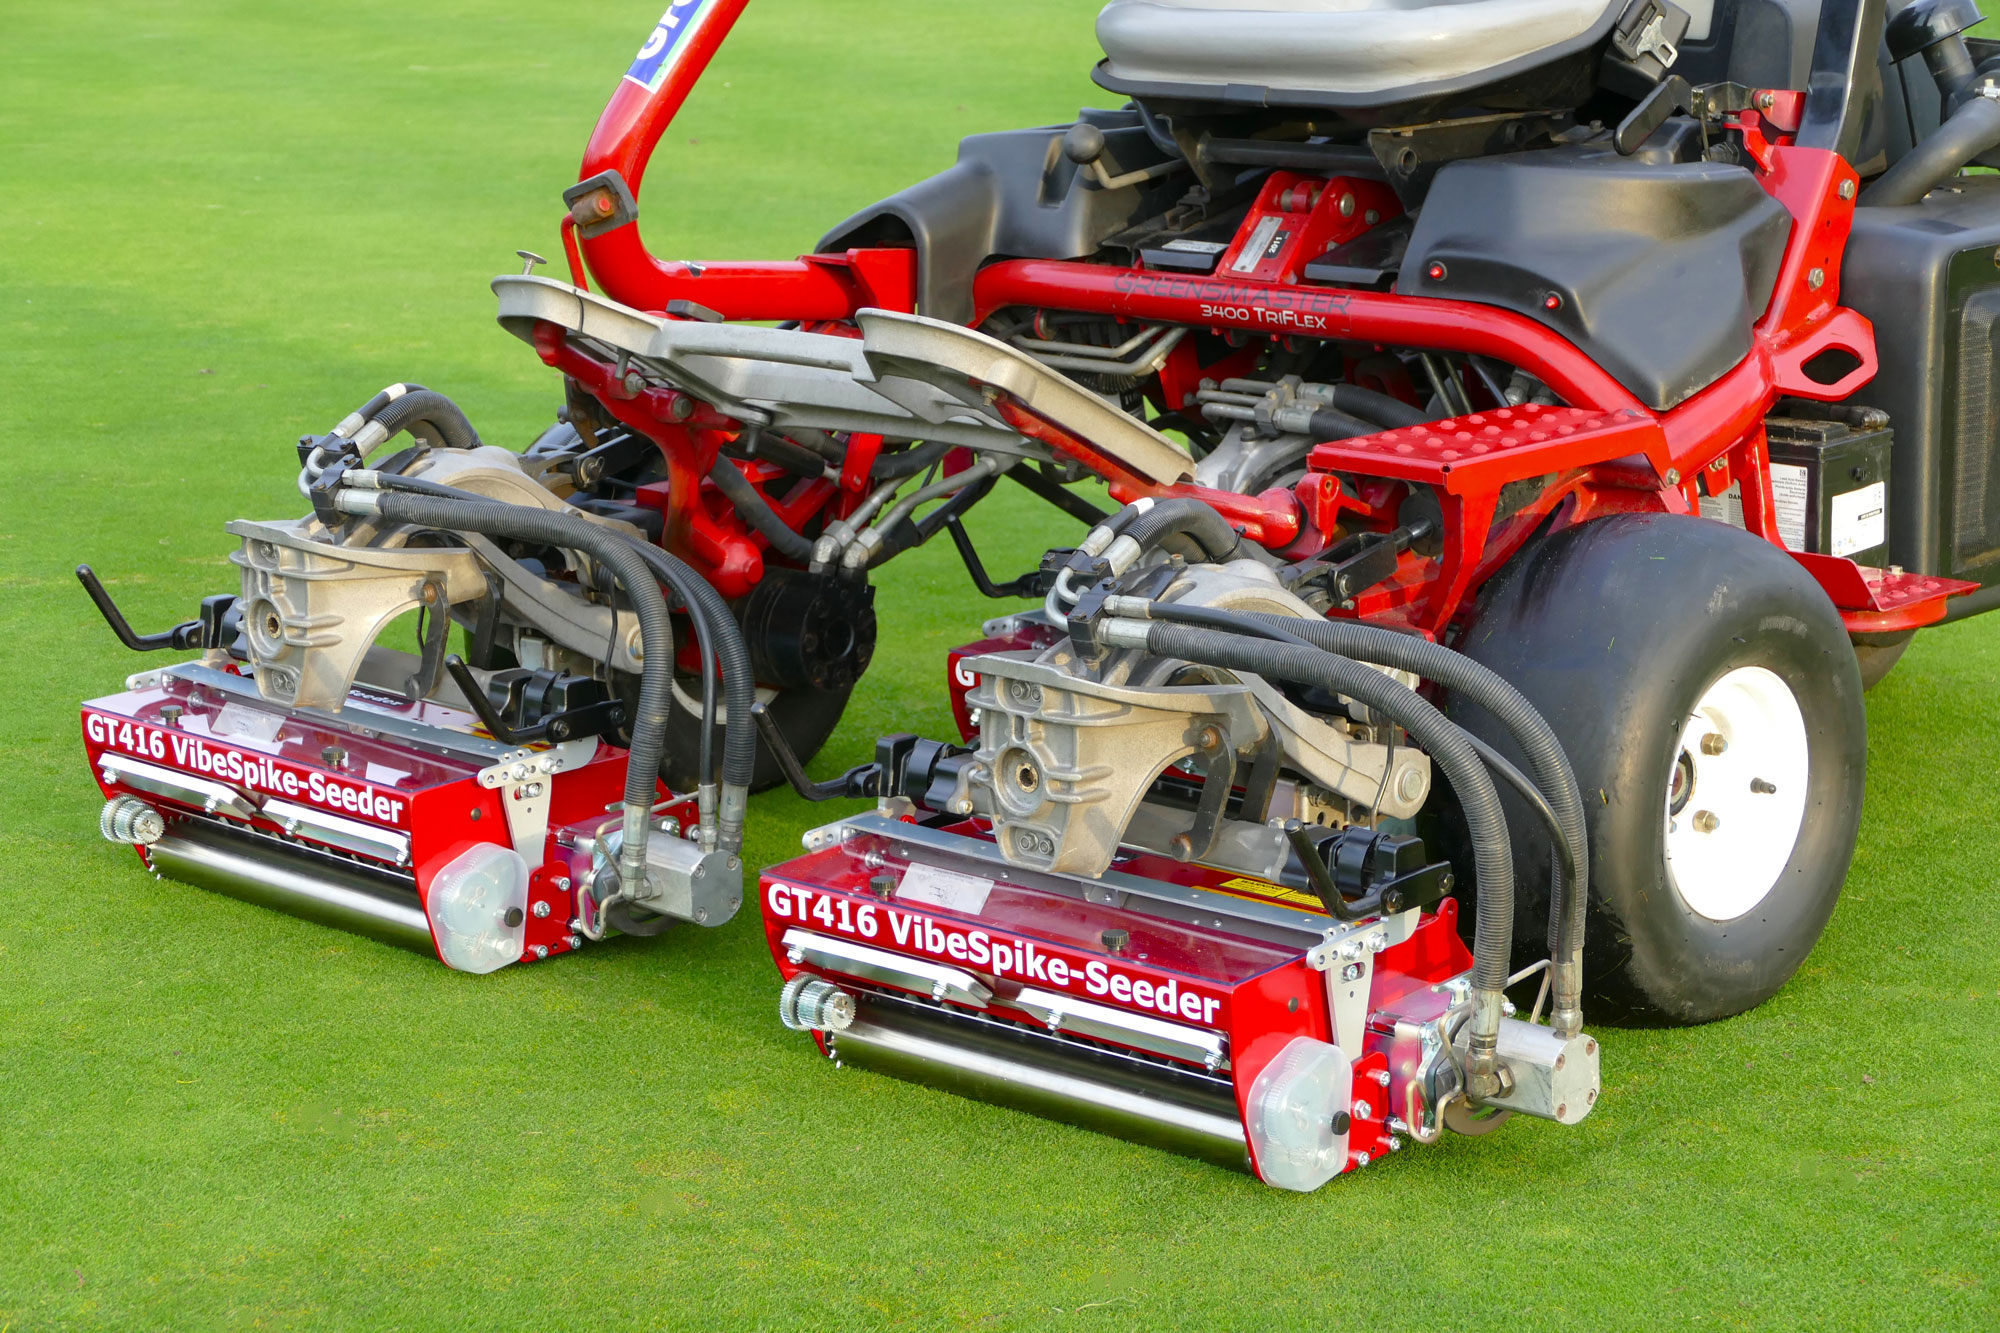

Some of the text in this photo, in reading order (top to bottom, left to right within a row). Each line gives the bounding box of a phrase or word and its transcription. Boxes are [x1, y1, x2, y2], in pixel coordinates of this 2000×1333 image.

[1268, 236, 1282, 253] 2011
[1114, 273, 1351, 315] GREENSMASTER
[1200, 304, 1250, 321] 3400
[87, 713, 165, 760] GT416
[170, 738, 403, 824] VibeSpike-Seeder
[768, 883, 879, 938] GT416
[888, 910, 1221, 1024] VibeSpike-Seeder
